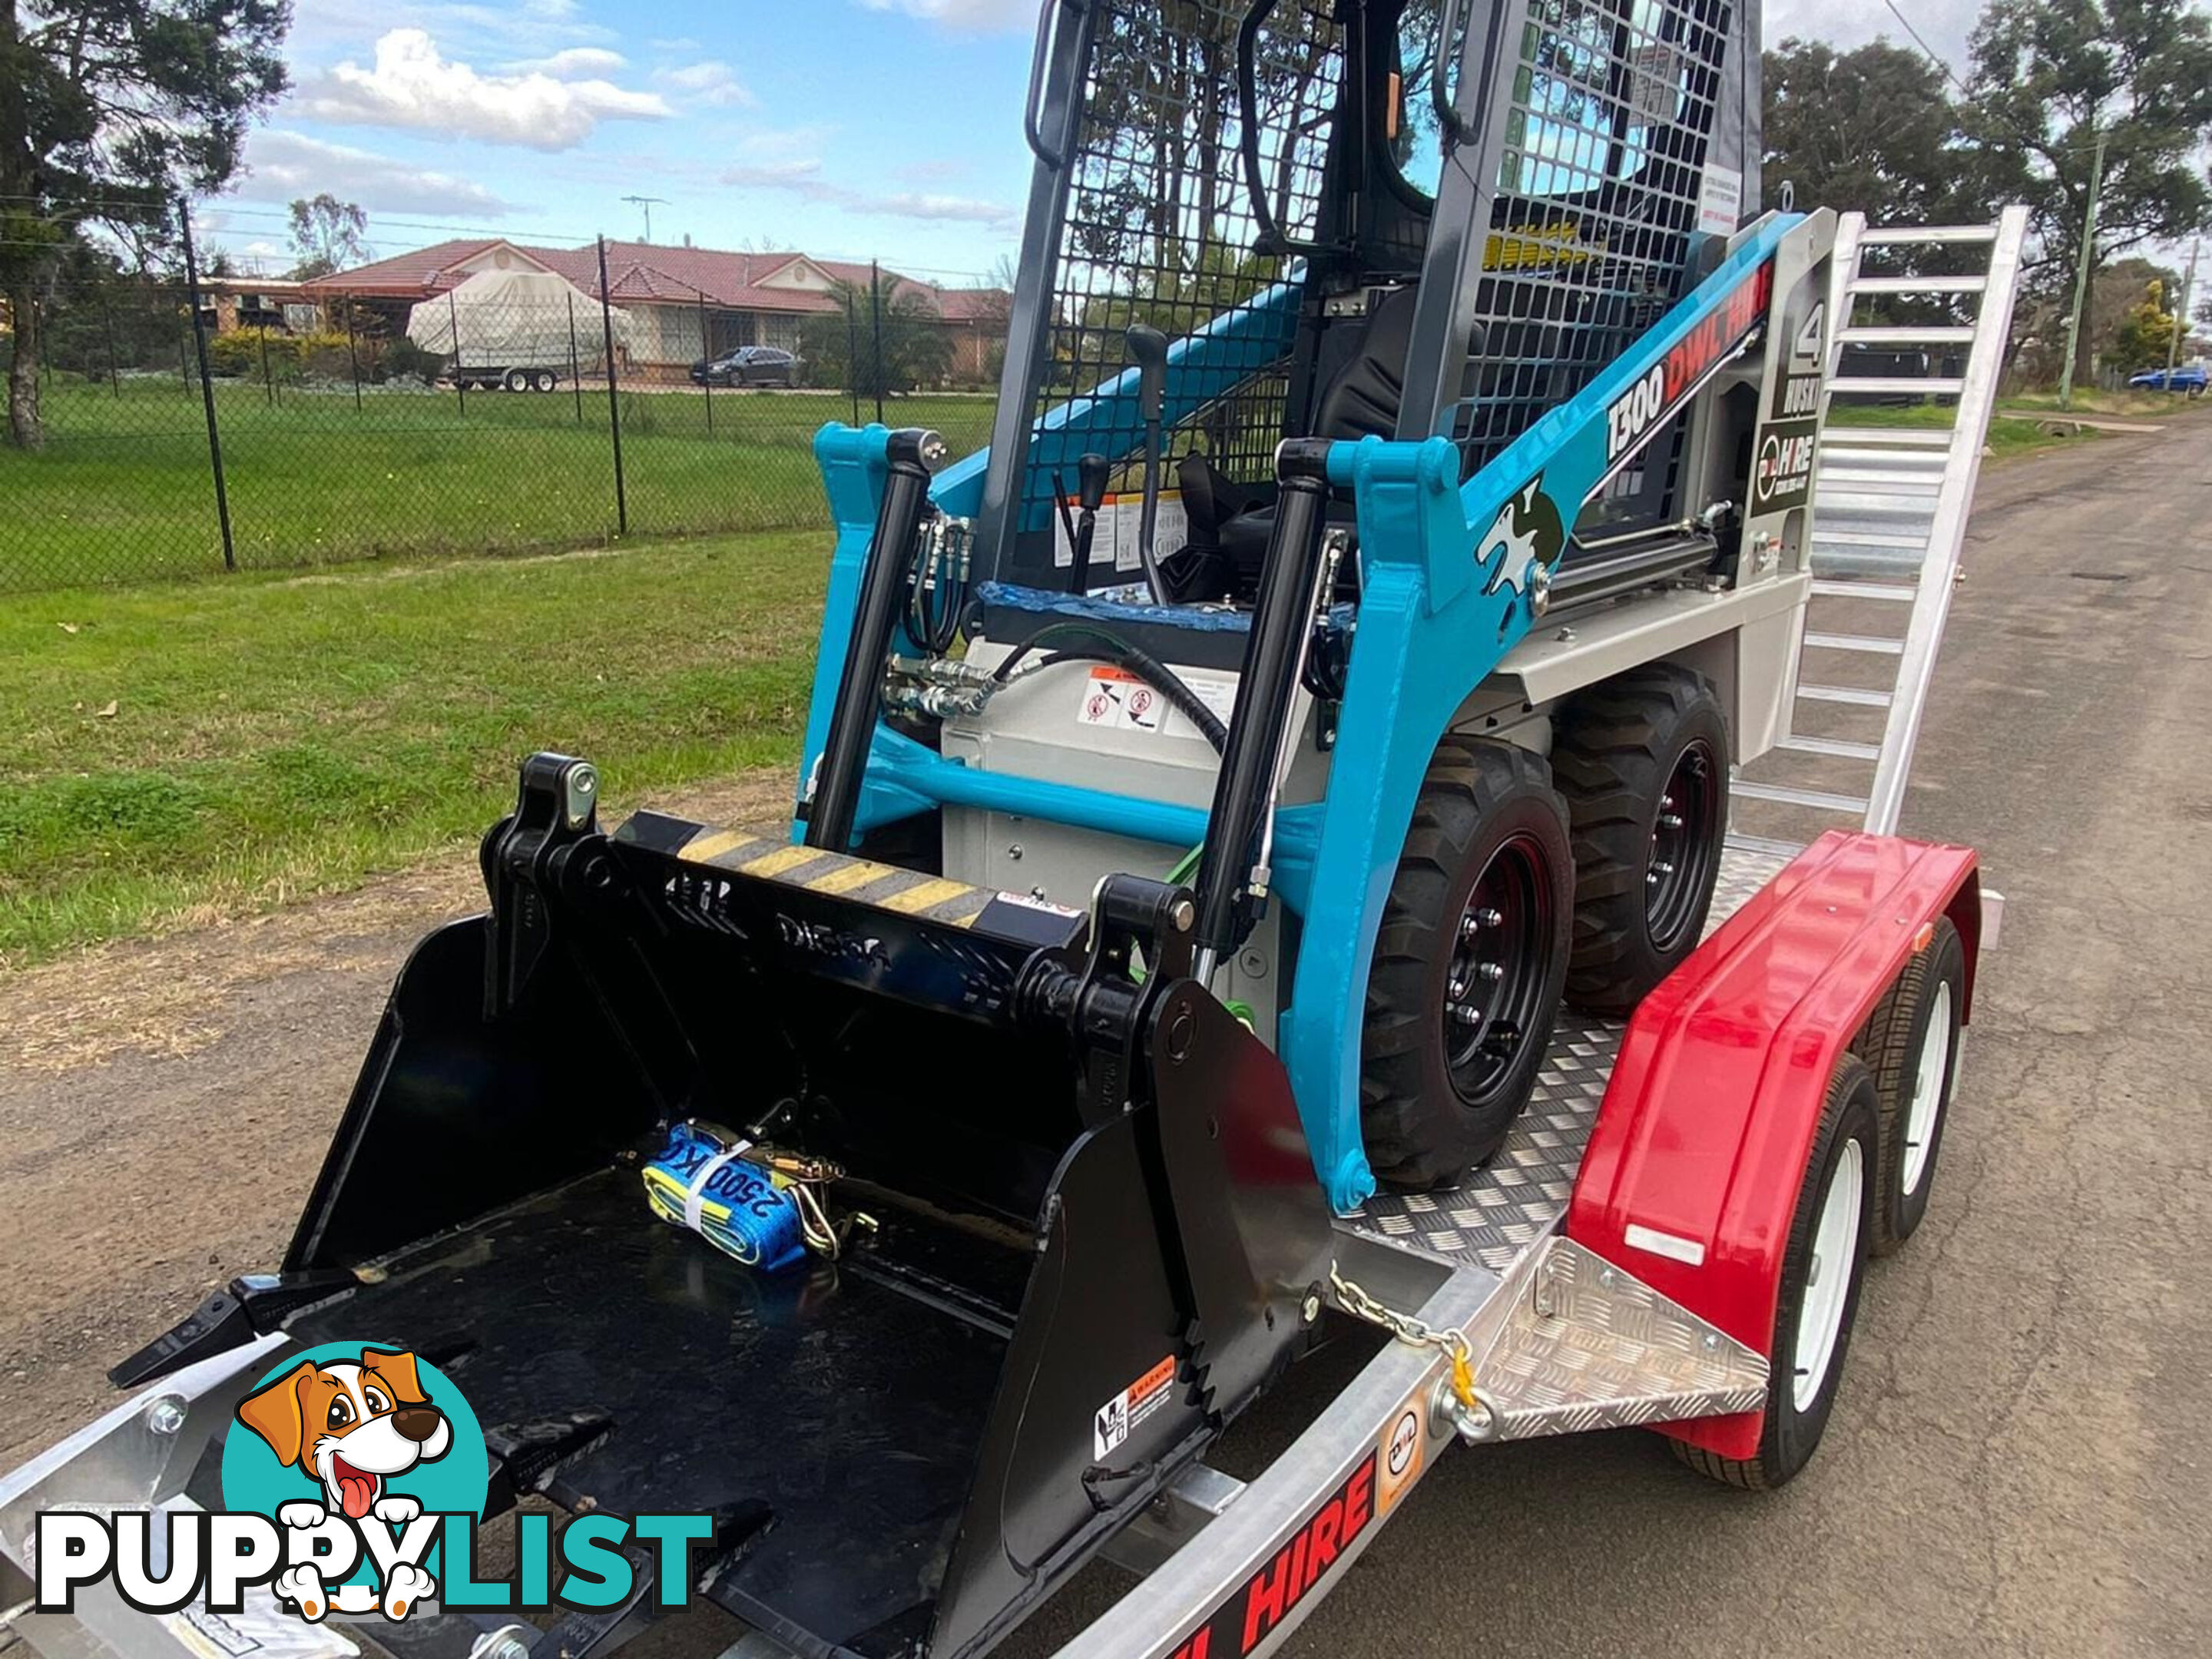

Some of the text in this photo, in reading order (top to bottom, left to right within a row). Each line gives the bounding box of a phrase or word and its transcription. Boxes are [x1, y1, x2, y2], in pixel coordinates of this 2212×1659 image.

[1796, 302, 1824, 367] 4
[1608, 363, 1664, 461] 1300
[1666, 312, 1720, 404] DWL
[1777, 435, 1814, 476] HIRE
[705, 1165, 785, 1217] 2500
[1241, 1457, 1376, 1654] HIRE
